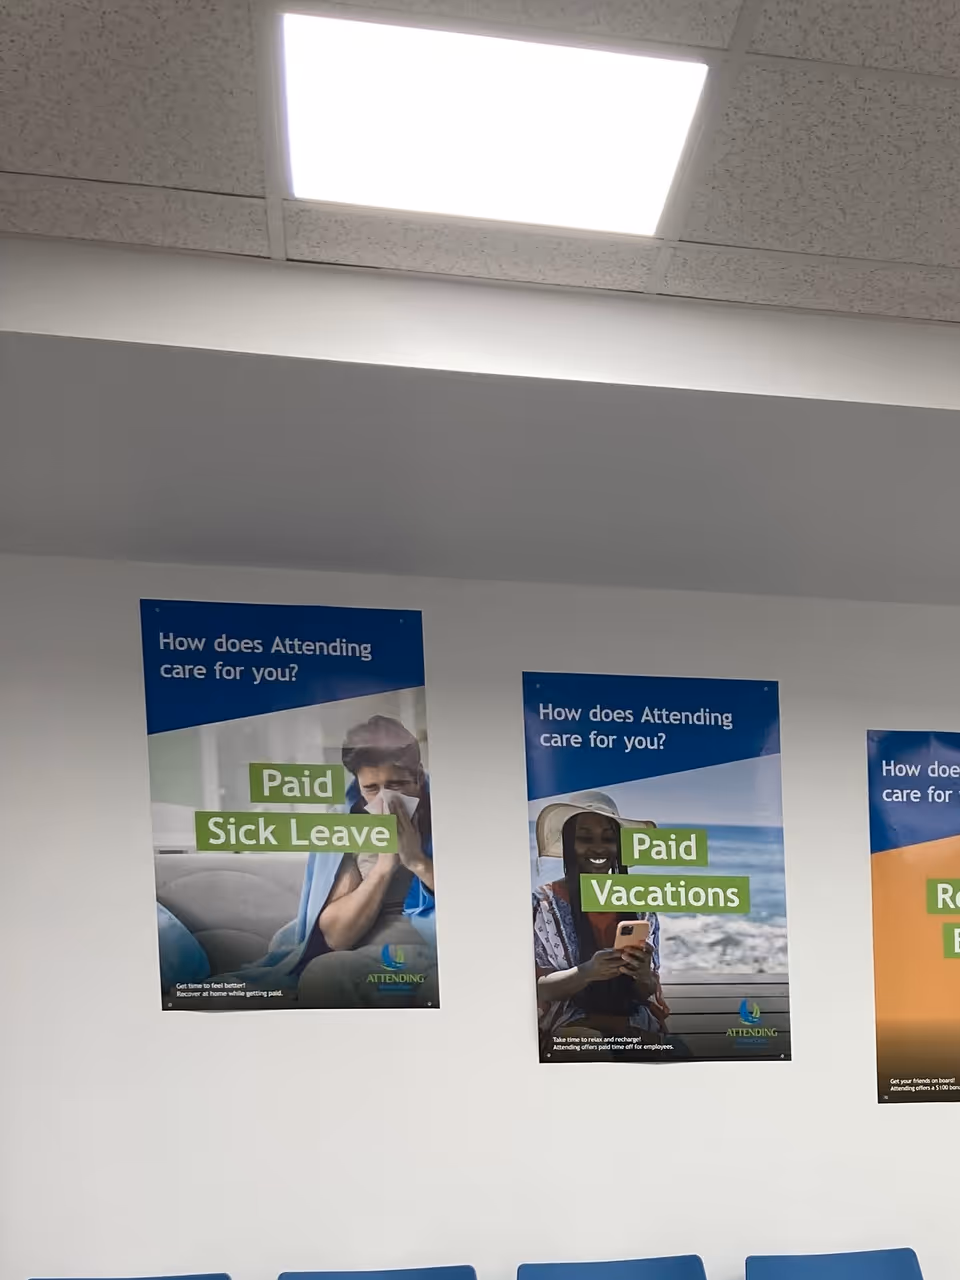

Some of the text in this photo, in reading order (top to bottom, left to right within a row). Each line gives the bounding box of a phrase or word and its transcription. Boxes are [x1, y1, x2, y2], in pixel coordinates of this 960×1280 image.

[159, 632, 372, 661] How does Attending
[160, 661, 298, 684] care for you?
[539, 703, 733, 730] How does Attending
[540, 731, 666, 753] care for you?
[882, 760, 921, 776] How
[262, 769, 333, 797] Paid
[882, 788, 921, 802] care
[927, 786, 953, 803] for
[208, 817, 390, 847] Sick Leave
[632, 833, 697, 860] Paid
[591, 879, 740, 907] Vacations
[366, 973, 425, 983] ATTENDING
[246, 990, 267, 998] getting
[726, 1028, 778, 1037] ATTENDING
